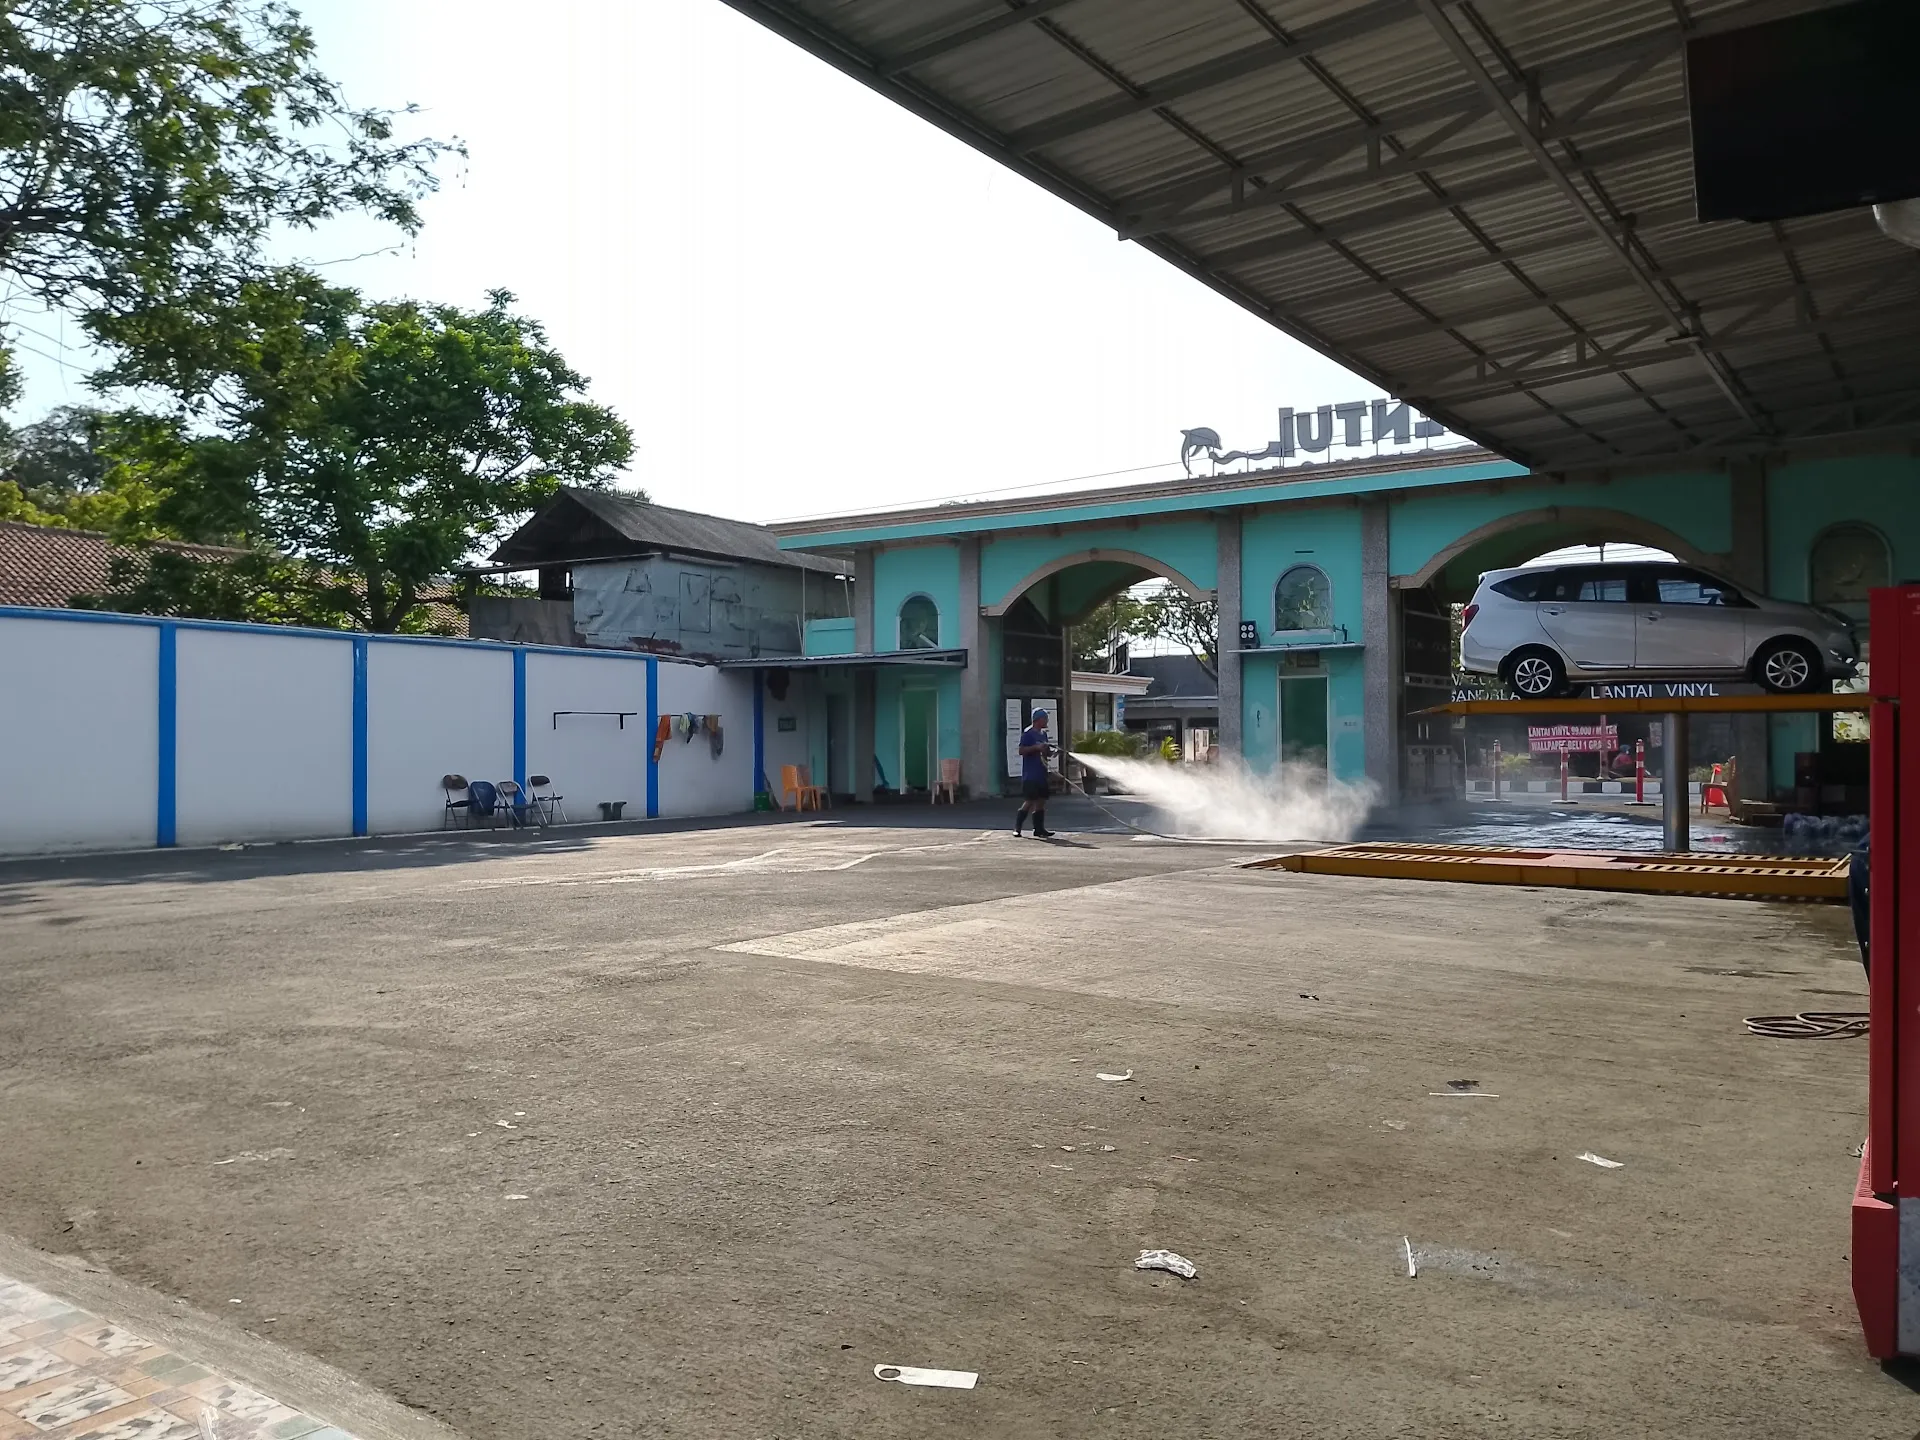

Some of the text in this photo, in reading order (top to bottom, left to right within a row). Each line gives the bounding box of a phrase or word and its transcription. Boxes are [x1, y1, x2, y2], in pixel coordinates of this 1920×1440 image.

[1590, 683, 1719, 699] LANTAI VINYL
[1528, 727, 1550, 738] LANTAI
[1551, 726, 1570, 737] VINYL
[1596, 724, 1618, 735] MTER
